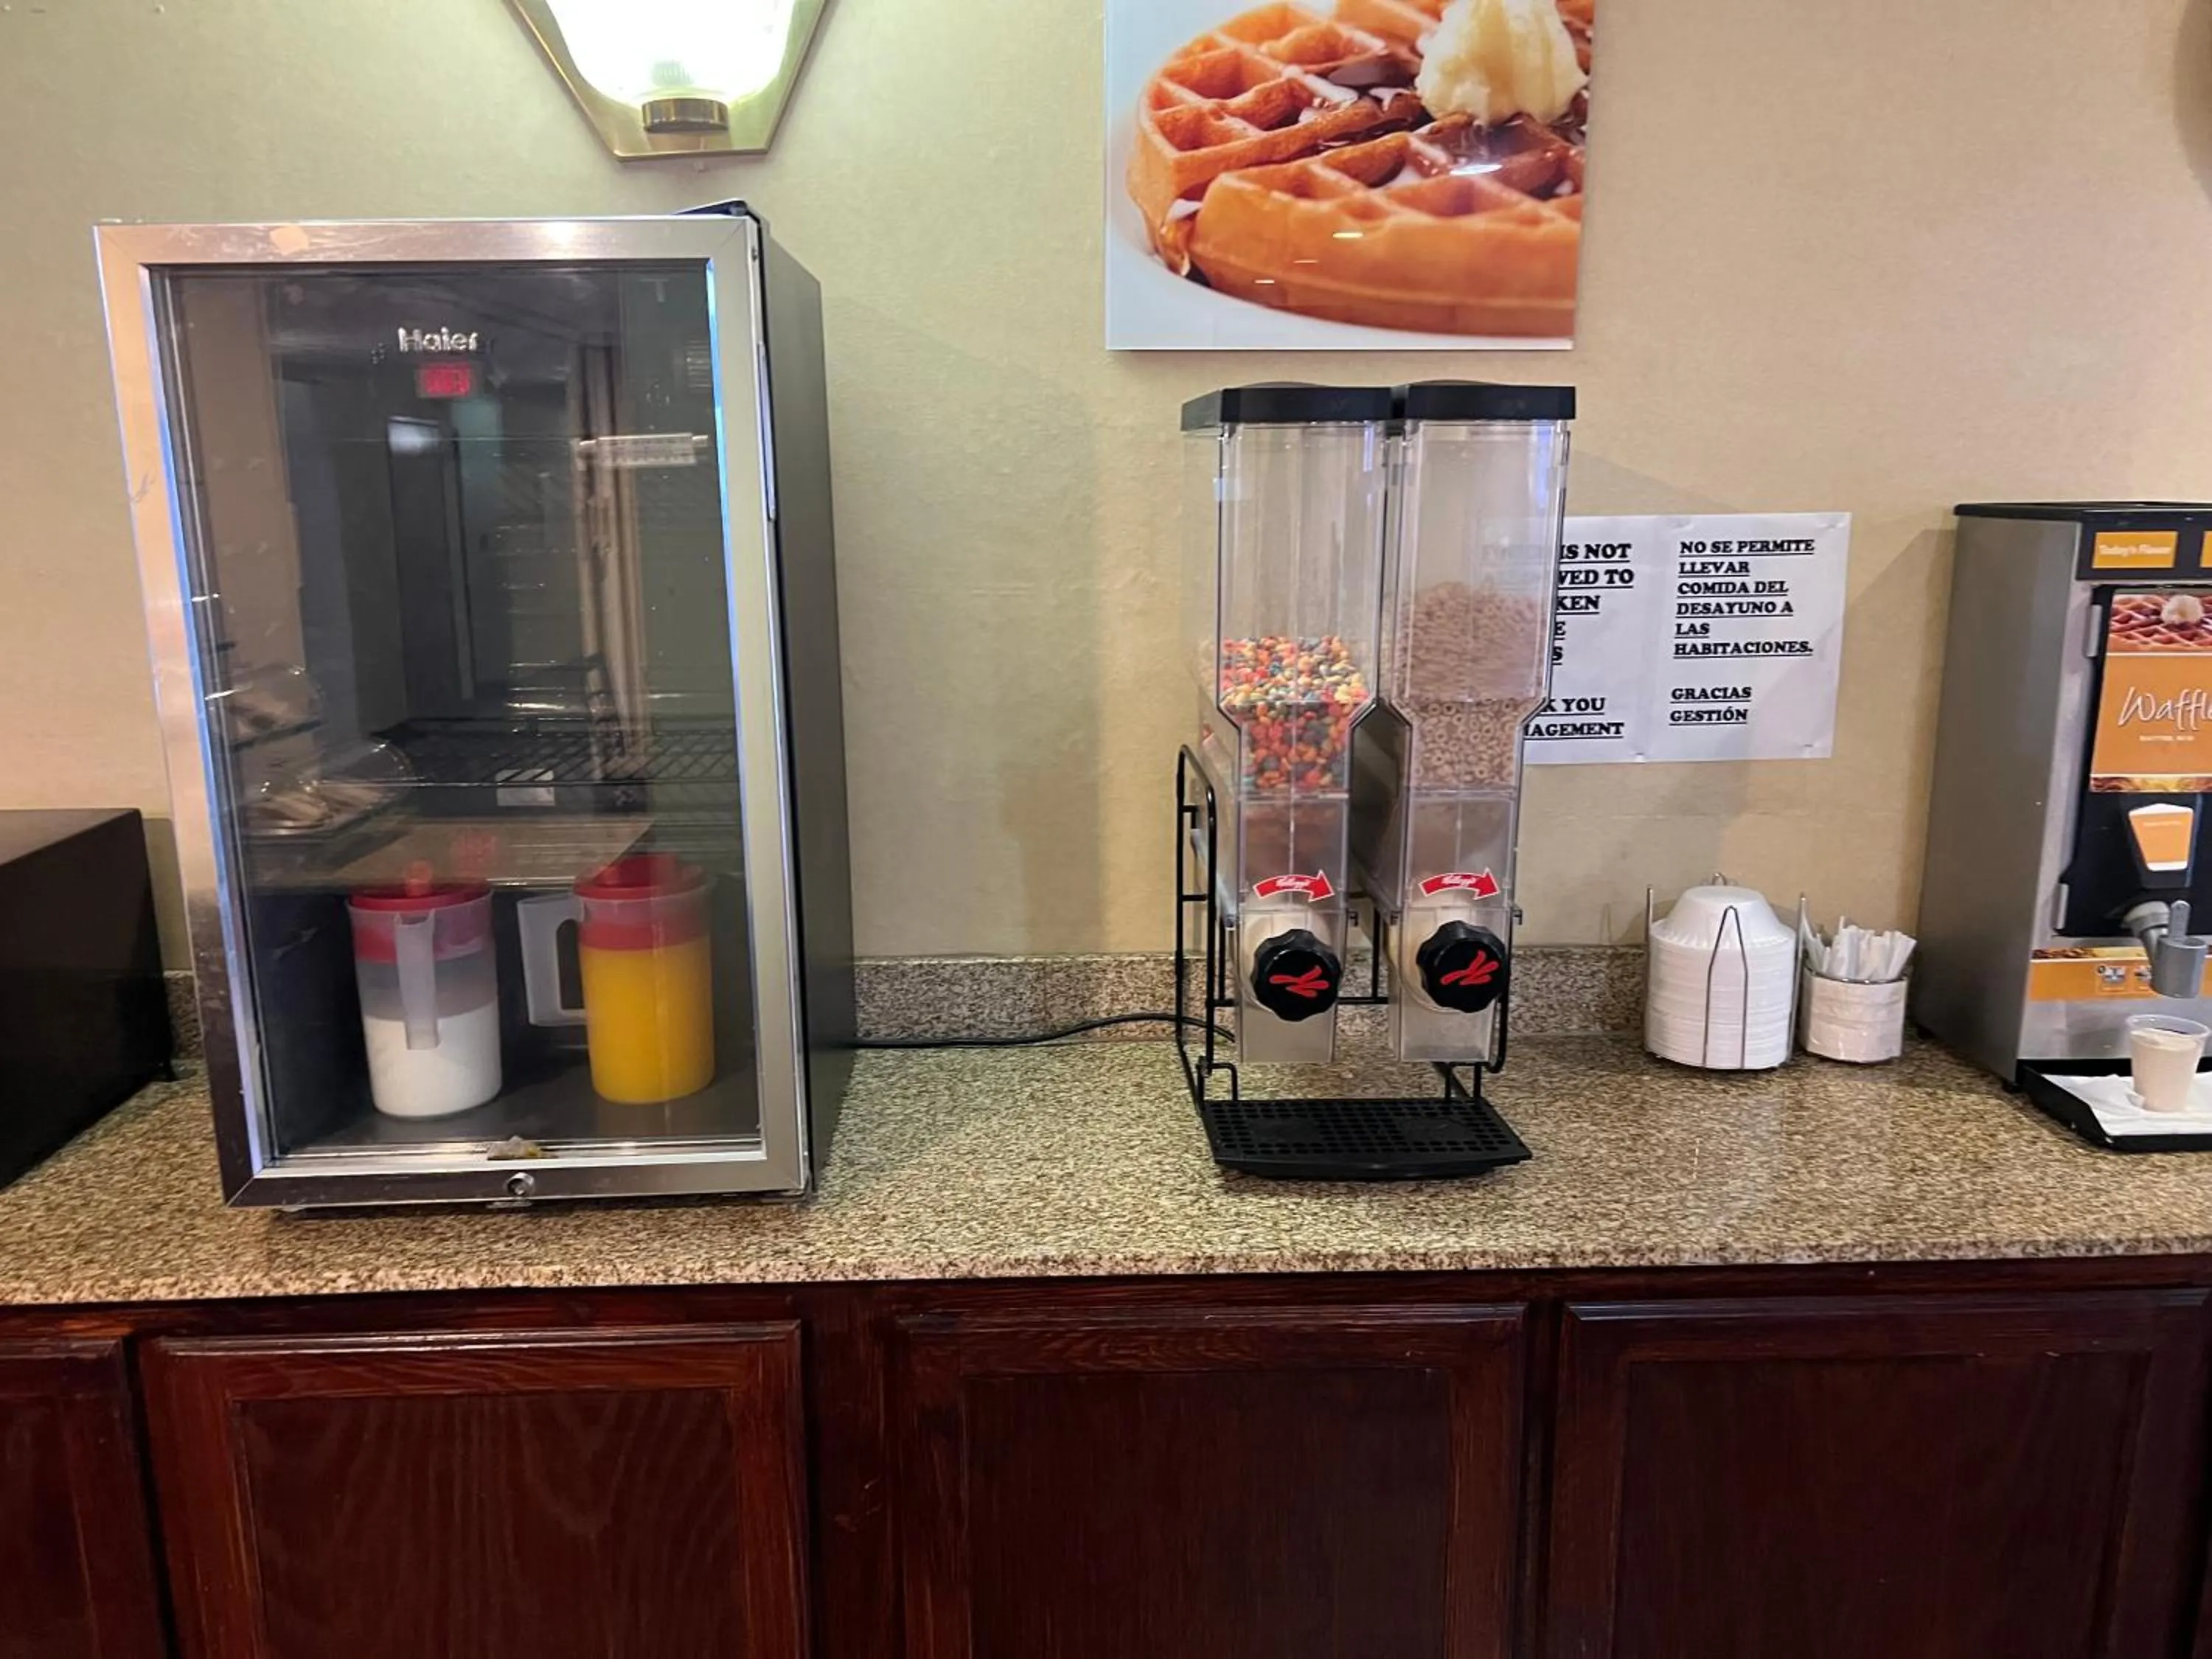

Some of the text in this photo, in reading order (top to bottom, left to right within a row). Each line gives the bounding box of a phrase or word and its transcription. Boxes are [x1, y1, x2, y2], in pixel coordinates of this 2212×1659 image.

[398, 326, 478, 352] Haier
[1584, 543, 1632, 559] NOT
[1680, 539, 1815, 554] NO SE PERMITE
[1679, 561, 1750, 574] LLEVAR
[1604, 568, 1634, 585] TO
[1677, 580, 1789, 594] COMIDA DEL
[1557, 595, 1601, 611] KEN
[1676, 601, 1793, 615] DESAYUNO A
[1675, 623, 1710, 635] LAS
[1674, 641, 1814, 655] HABITACIONES.
[1671, 686, 1752, 700] GRACIAS
[1561, 698, 1606, 712] YOU
[1670, 706, 1748, 721] GESTIÓN
[1524, 723, 1624, 736] AGEMENT
